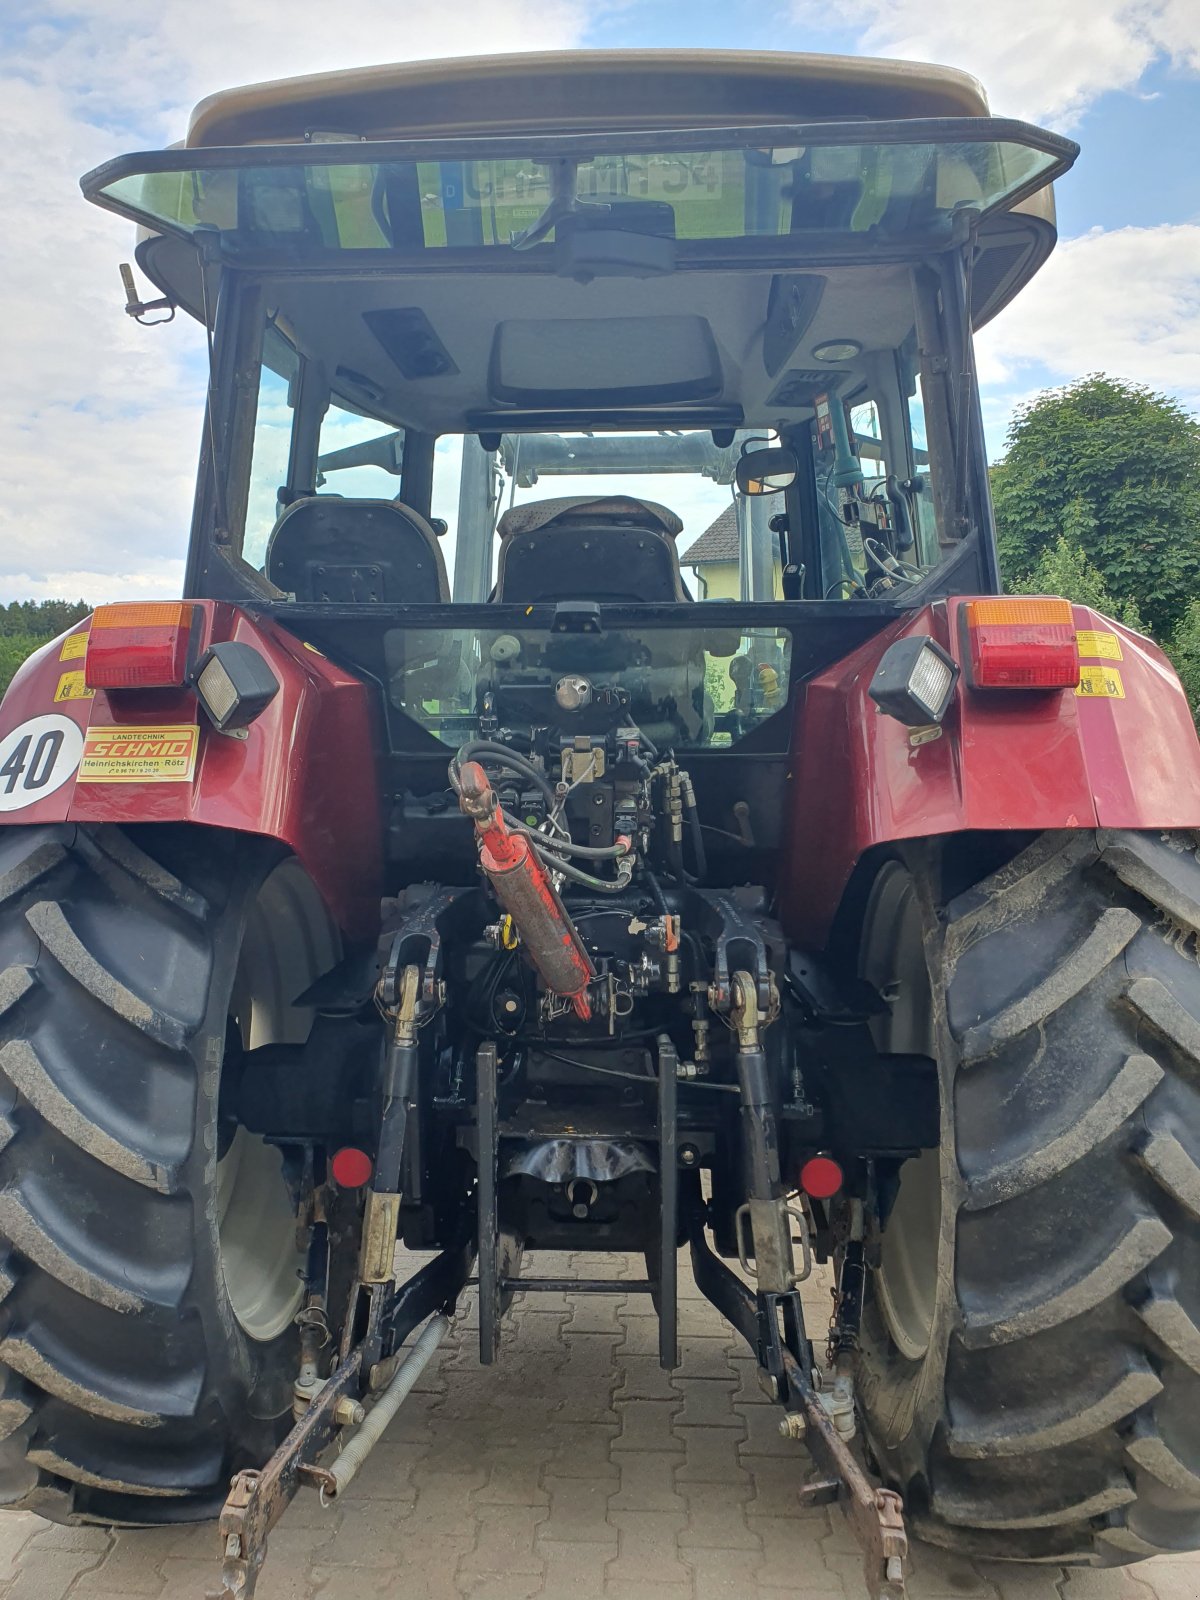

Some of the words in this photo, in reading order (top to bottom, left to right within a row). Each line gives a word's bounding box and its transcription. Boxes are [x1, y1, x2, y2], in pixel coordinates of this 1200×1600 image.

[112, 733, 166, 741] LANDTECHNIK
[85, 742, 188, 757] SCHMID
[0, 730, 64, 794] 40
[84, 760, 159, 768] Heinrichskirchen
[164, 759, 185, 767] Rötz
